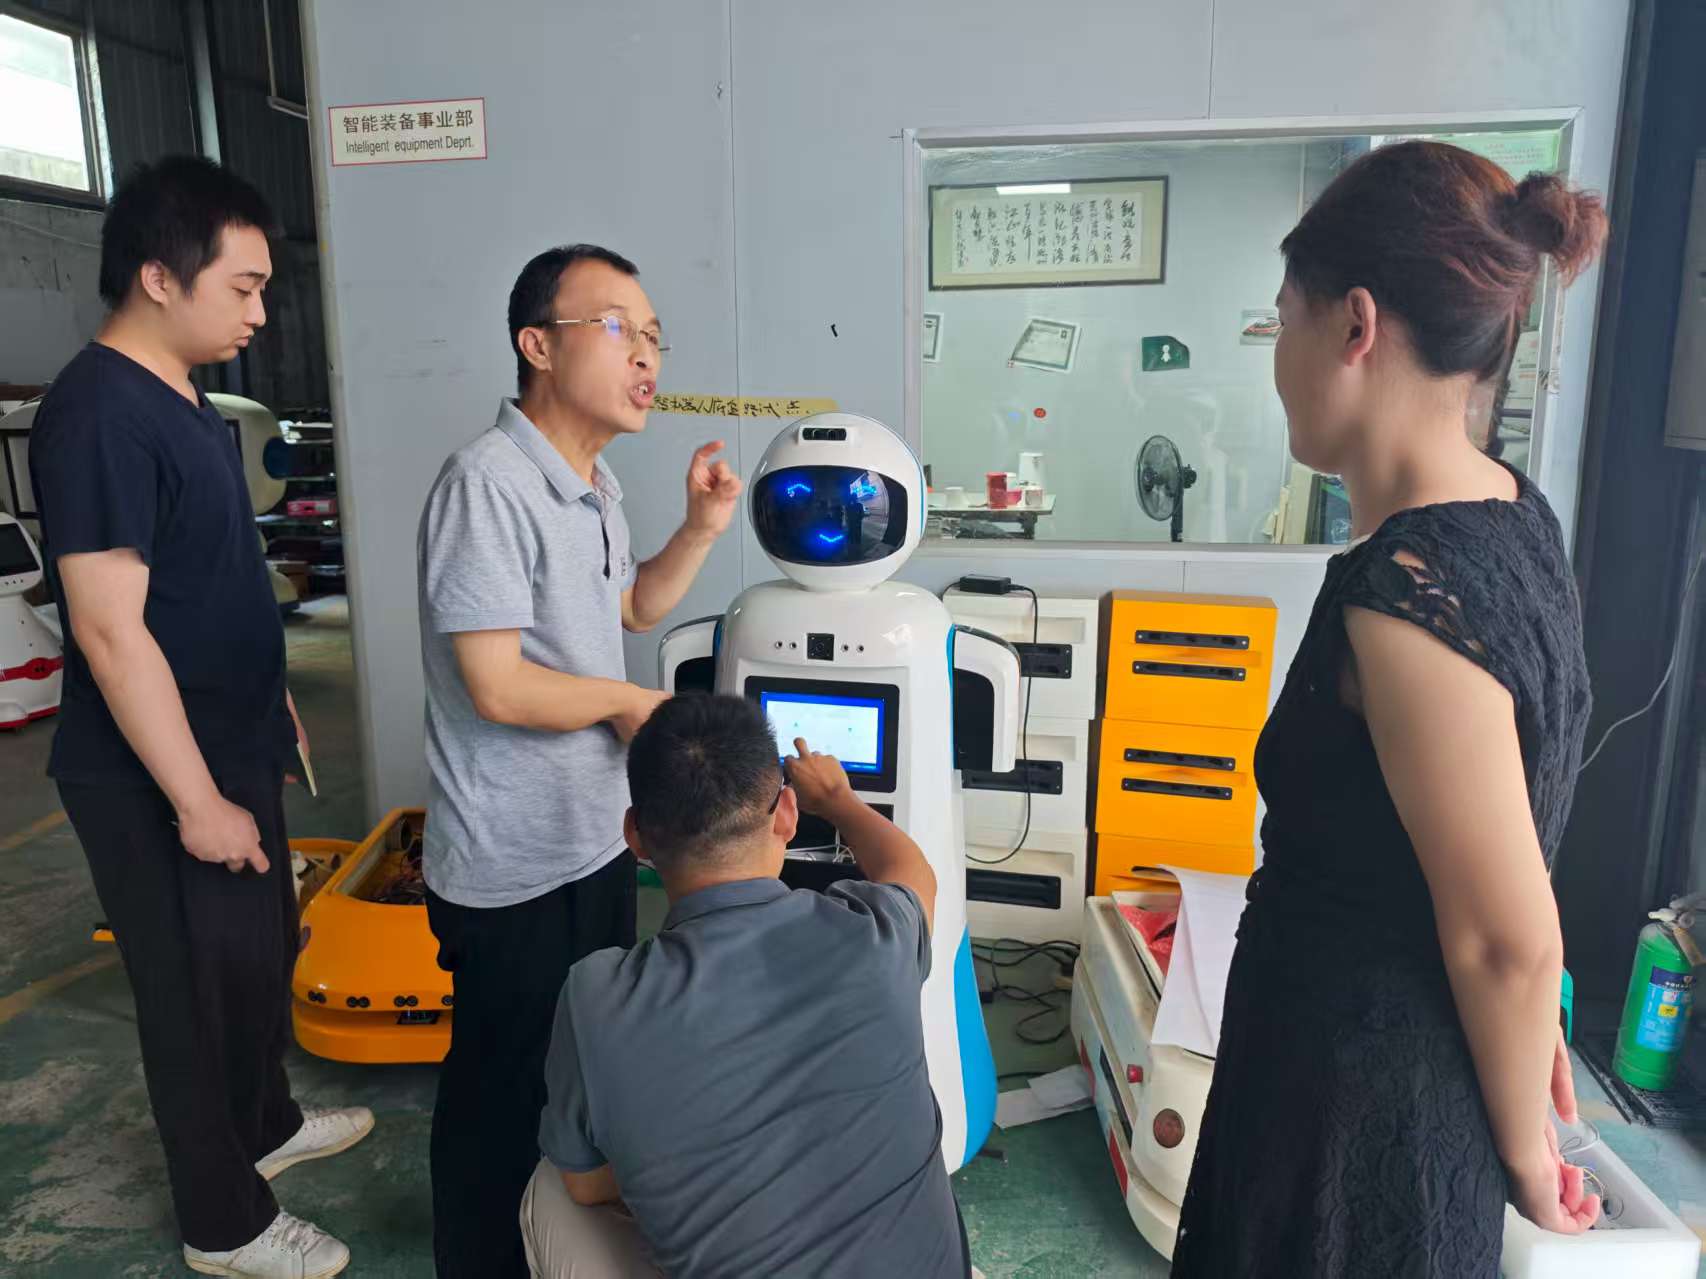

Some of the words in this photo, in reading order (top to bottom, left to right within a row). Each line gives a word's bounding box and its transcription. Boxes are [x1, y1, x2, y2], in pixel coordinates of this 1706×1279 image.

[343, 109, 473, 134] 智能装备事业部
[346, 139, 390, 156] Intelligent
[394, 137, 443, 154] equipment
